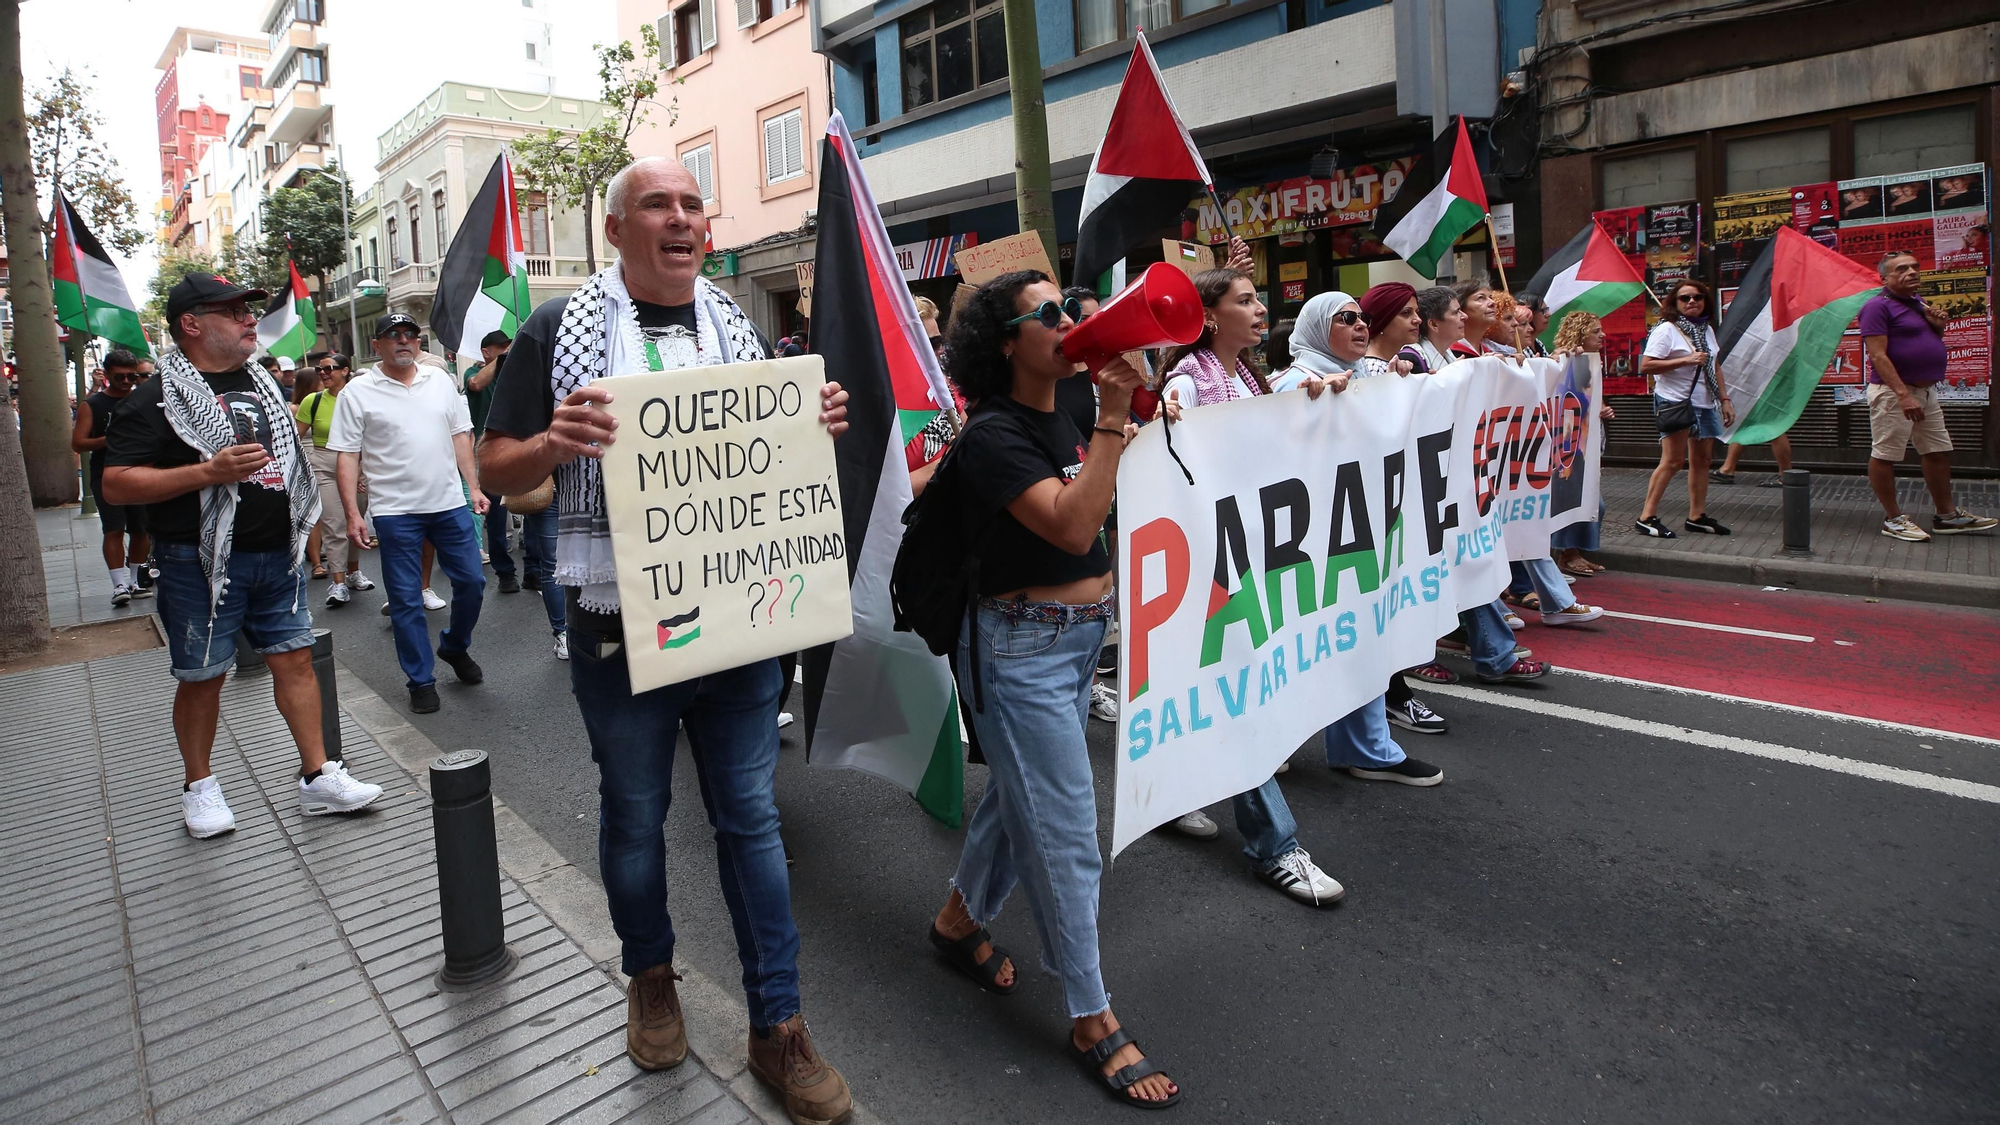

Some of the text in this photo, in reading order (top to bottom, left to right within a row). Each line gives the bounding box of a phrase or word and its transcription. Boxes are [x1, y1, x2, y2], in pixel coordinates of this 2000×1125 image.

[1338, 212, 1355, 221] 928
[1358, 209, 1369, 219] 03
[1937, 215, 1966, 225] LAURA
[1271, 216, 1329, 232] DOMICILIO
[1937, 220, 1977, 231] GALLEGO
[1841, 233, 1885, 244] HOKE
[1888, 228, 1933, 239] HOKE
[1060, 247, 1072, 259] 23
[1286, 284, 1302, 292] JUST
[1938, 284, 1952, 292] 15
[639, 381, 802, 439] QUERIDO
[637, 437, 783, 492] MUNDO:
[248, 472, 282, 482] GUEVARA
[645, 475, 837, 544] DÓNDE ESTÁ
[642, 533, 845, 600] TU HUMANIDAD
[1127, 644, 1288, 762] SALVAR
[1295, 610, 1358, 673] LAS
